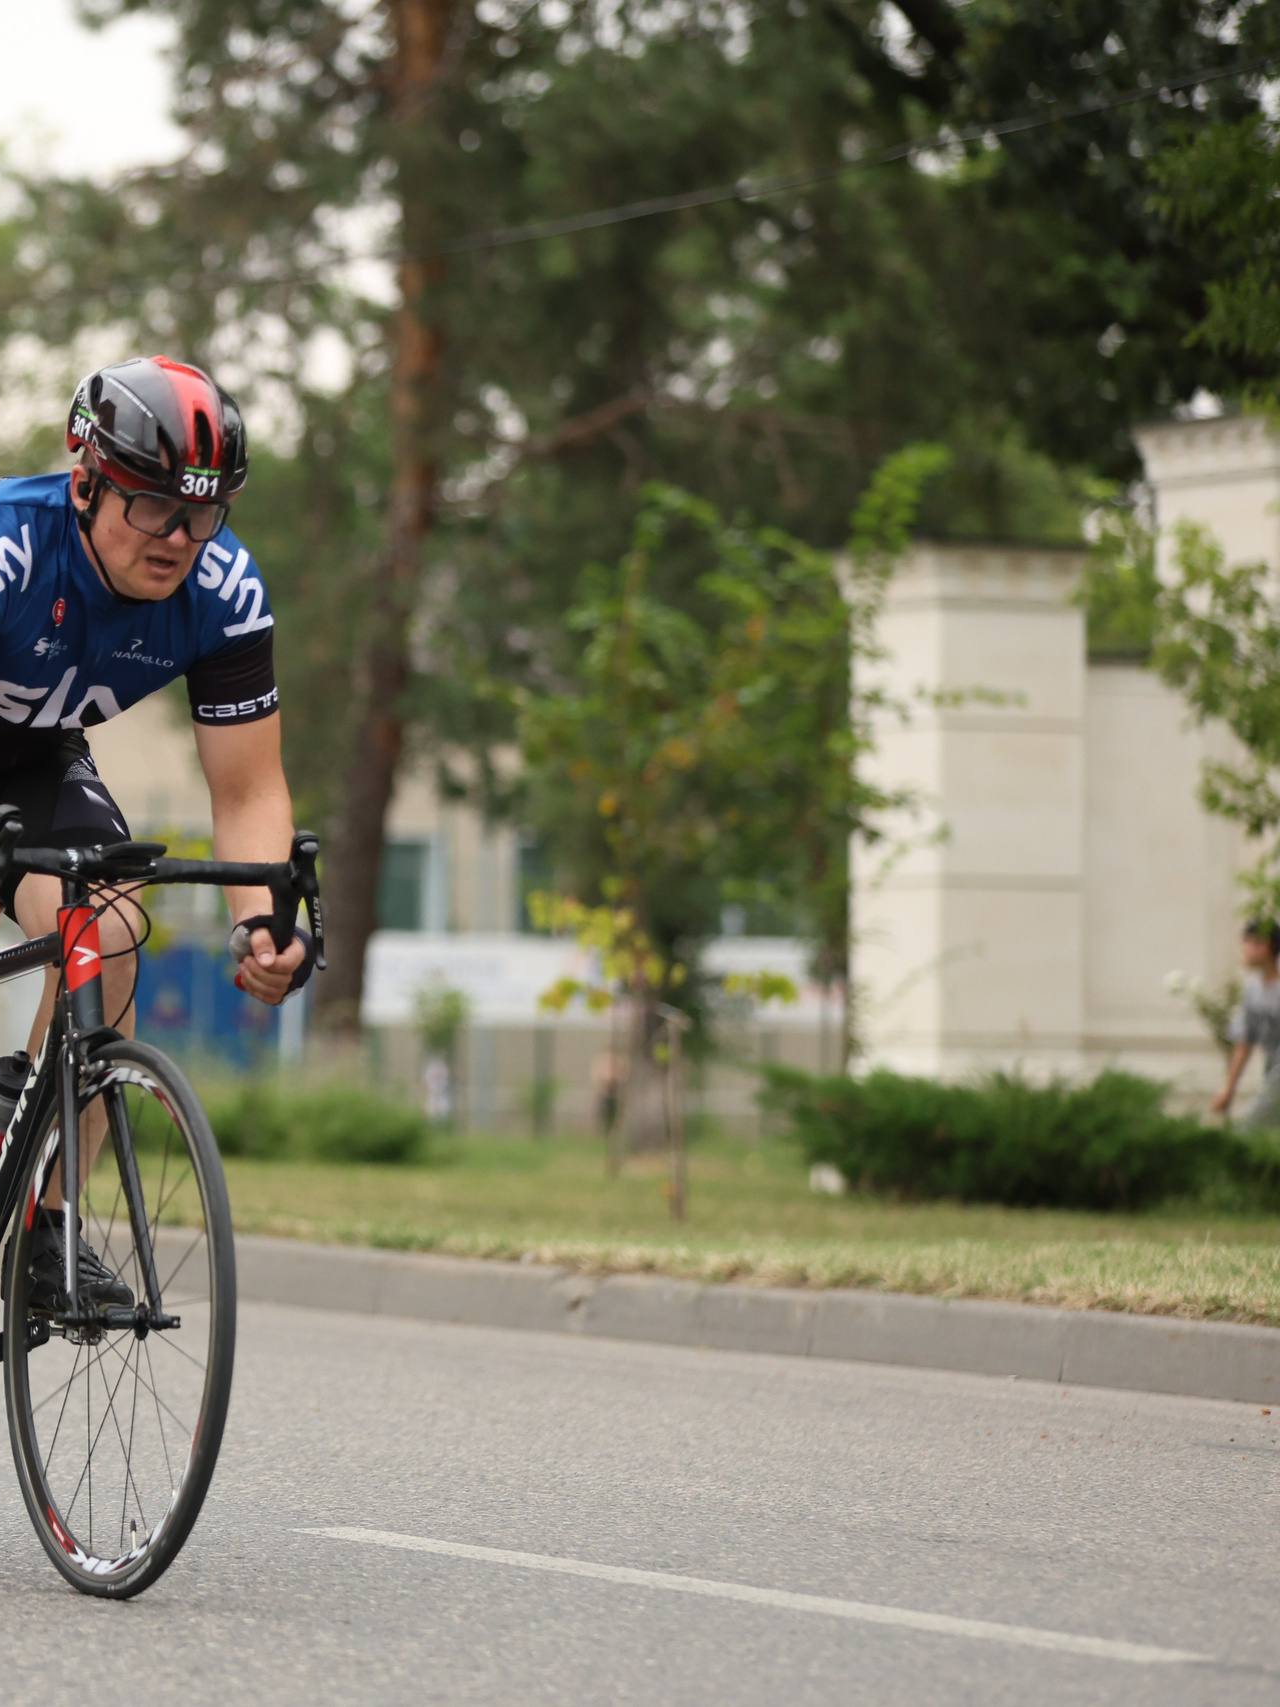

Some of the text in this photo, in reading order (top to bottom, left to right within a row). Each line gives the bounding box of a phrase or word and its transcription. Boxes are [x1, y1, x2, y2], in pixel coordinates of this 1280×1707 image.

[71, 414, 92, 441] 301
[180, 473, 219, 497] 301
[312, 896, 323, 938] IGNITE
